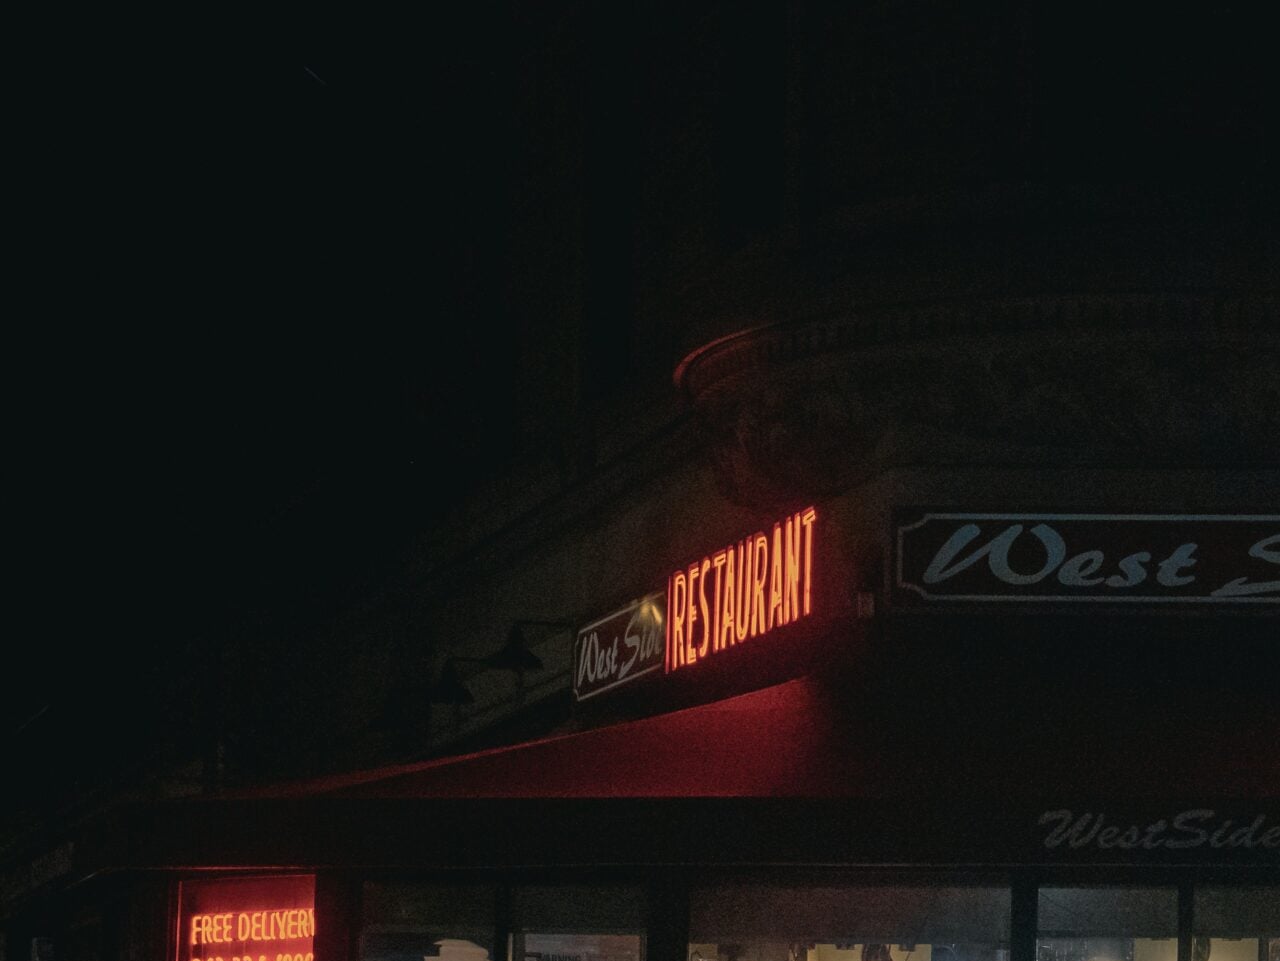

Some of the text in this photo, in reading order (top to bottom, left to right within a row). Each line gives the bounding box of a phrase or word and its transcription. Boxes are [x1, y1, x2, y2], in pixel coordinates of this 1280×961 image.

[922, 523, 1200, 588] West
[672, 506, 817, 670] RESTAURANT
[577, 630, 619, 688] West
[190, 912, 233, 945] FREE
